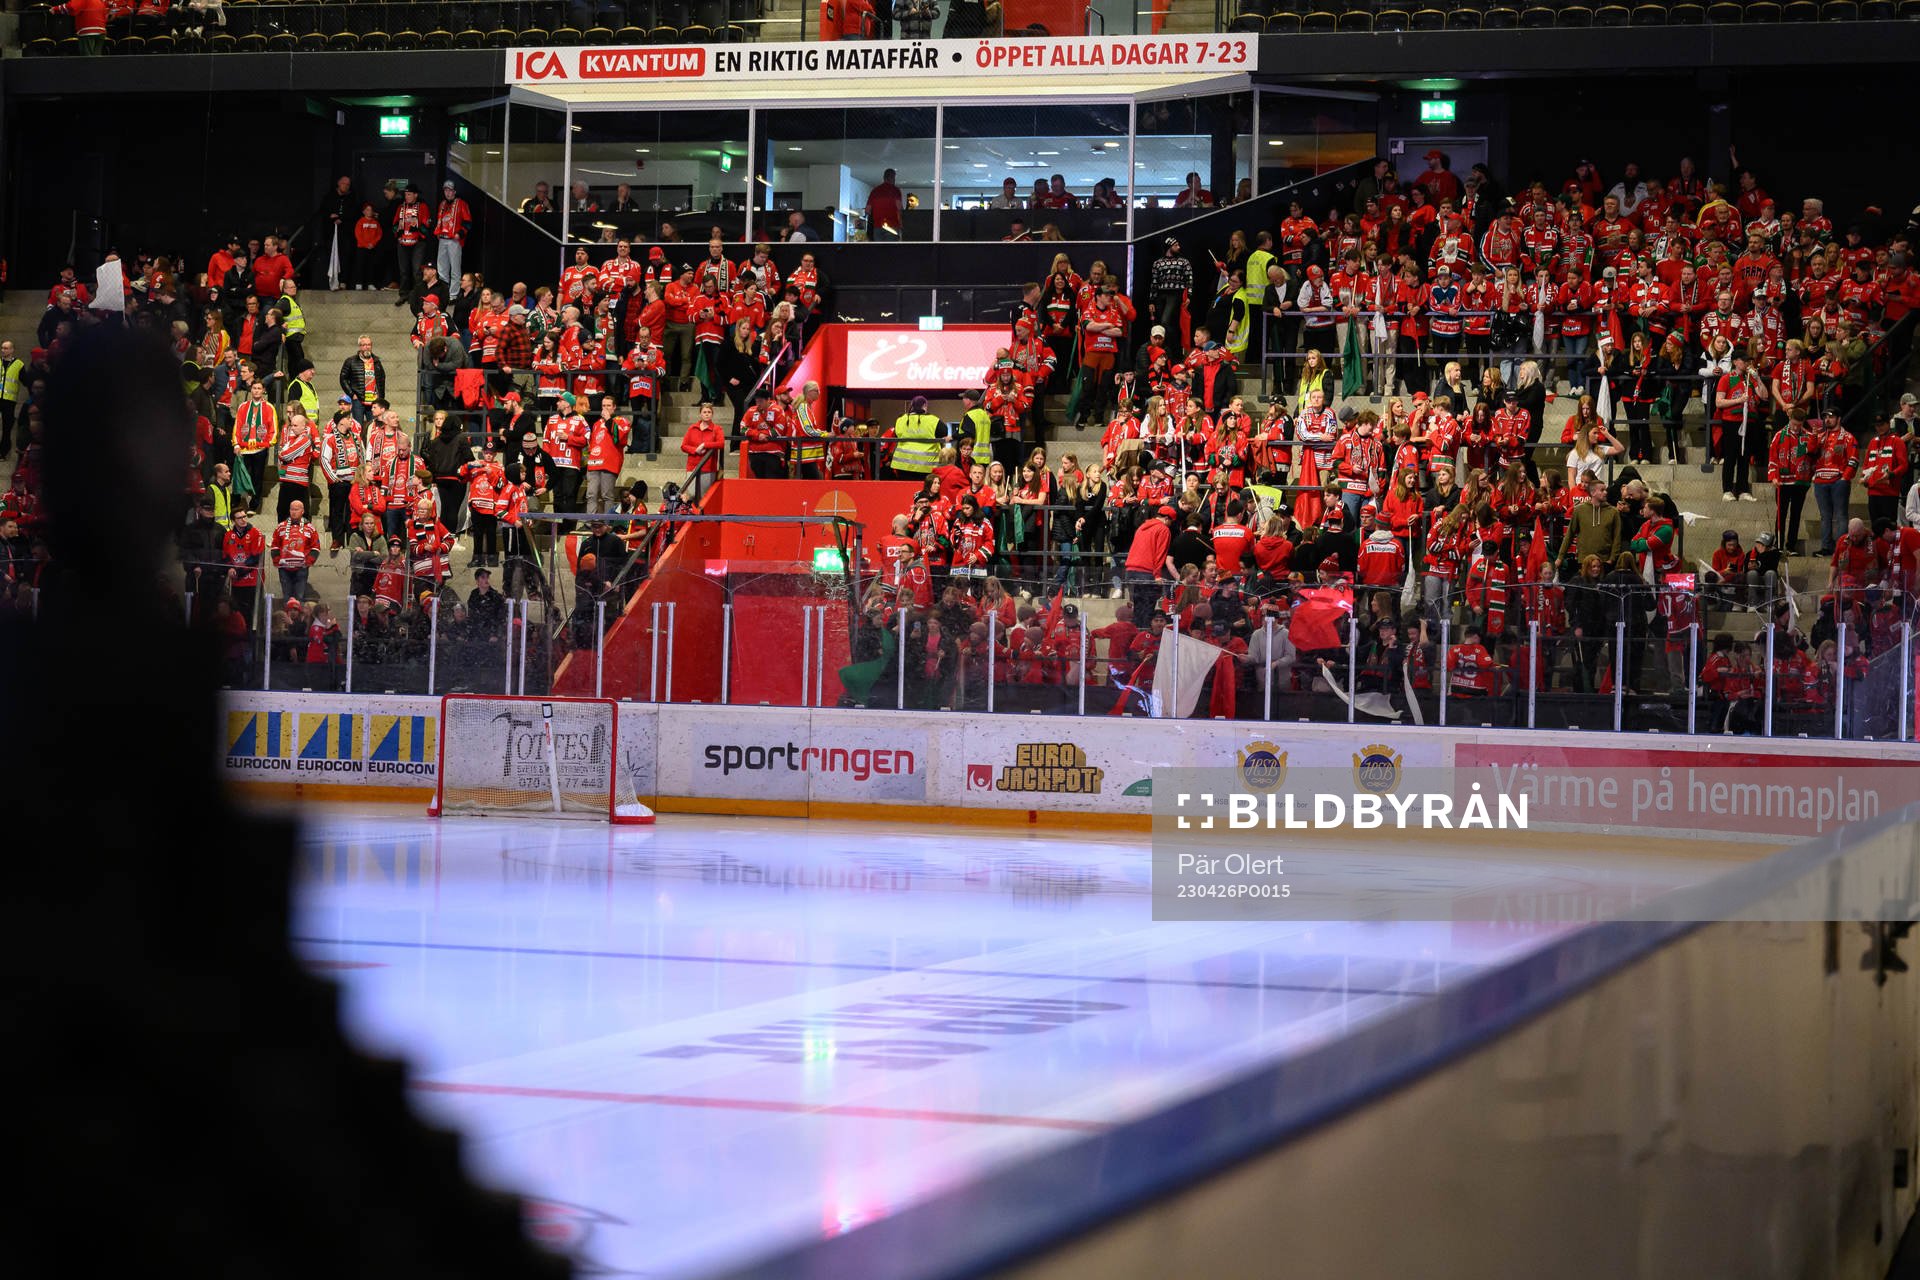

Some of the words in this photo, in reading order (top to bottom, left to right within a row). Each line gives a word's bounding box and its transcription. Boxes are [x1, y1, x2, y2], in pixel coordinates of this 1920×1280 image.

[516, 51, 568, 79] ICA
[586, 51, 698, 72] KVANTUM
[715, 51, 741, 72] EN
[749, 49, 818, 71] RIKTIG
[826, 42, 938, 70] MATAFFÄR
[976, 40, 1046, 68] ÖPPET
[1050, 45, 1105, 66] ALLA
[1111, 43, 1188, 65] DAGAR
[1195, 41, 1246, 63] 7-23
[907, 362, 941, 380] övik
[226, 758, 291, 769] EUROCON
[297, 759, 362, 772] EUROCON
[704, 742, 914, 781] sportringen
[1016, 743, 1079, 767] EURO
[368, 761, 435, 774] EUROCON
[996, 766, 1101, 793] JACKPOT
[1490, 762, 1619, 808] Värme
[1632, 766, 1674, 822] på
[1689, 768, 1880, 833] hemmaplan
